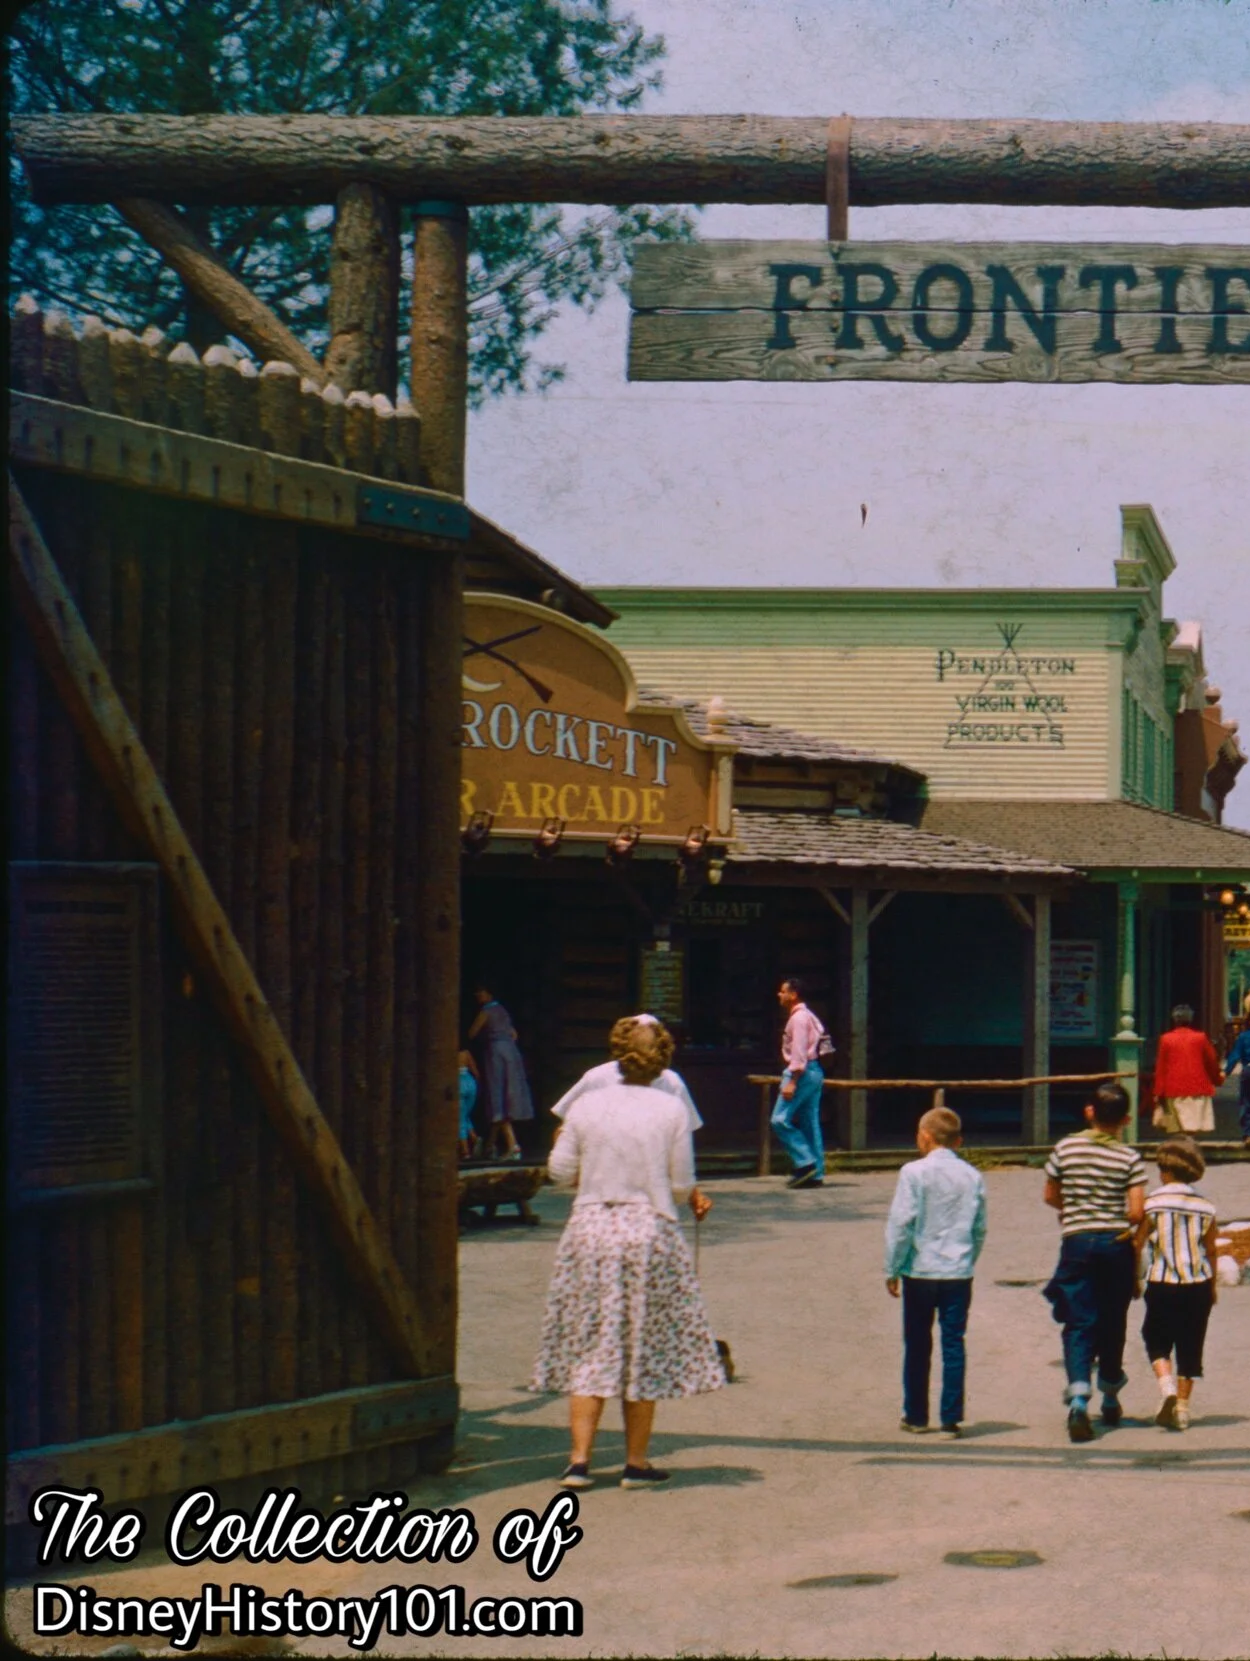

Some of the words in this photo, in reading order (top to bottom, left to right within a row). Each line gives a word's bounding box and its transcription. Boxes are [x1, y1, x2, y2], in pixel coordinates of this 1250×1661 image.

[936, 649, 1076, 682] PENDLETON
[955, 695, 1015, 712] VIRGIN
[1023, 695, 1068, 712] WOOL
[947, 723, 1064, 742] PRODUCTS
[497, 781, 666, 824] ARCADE
